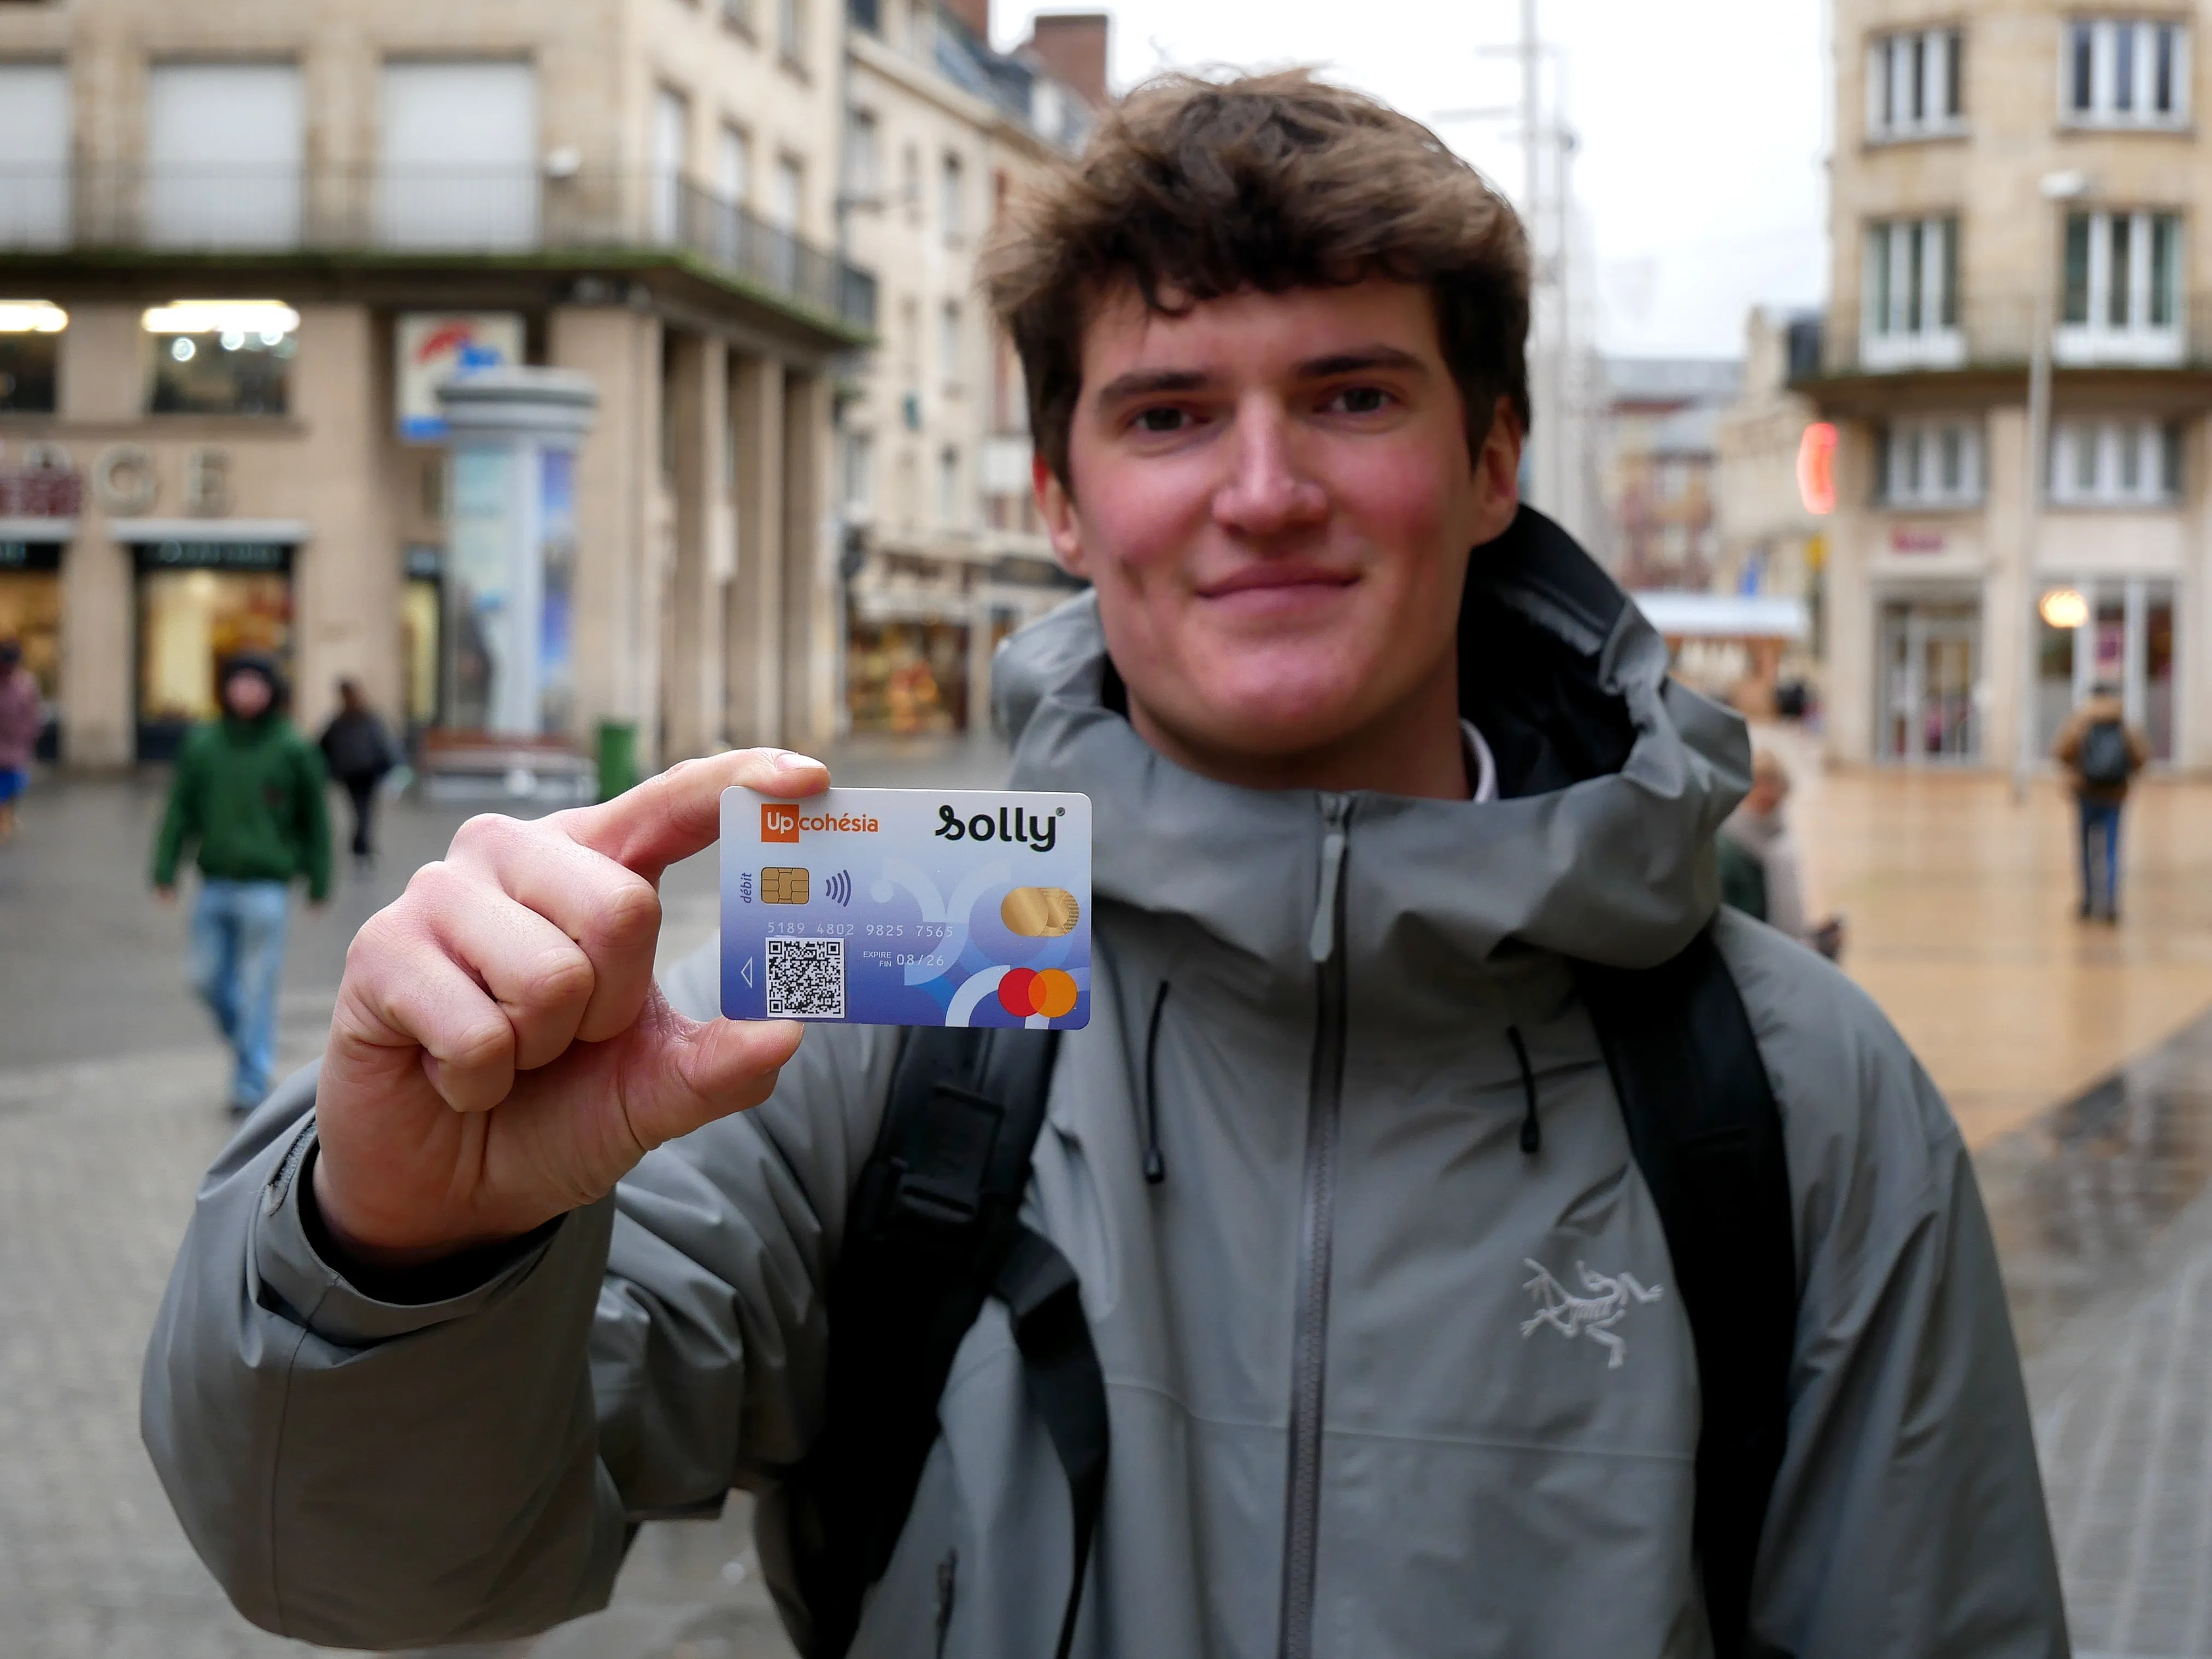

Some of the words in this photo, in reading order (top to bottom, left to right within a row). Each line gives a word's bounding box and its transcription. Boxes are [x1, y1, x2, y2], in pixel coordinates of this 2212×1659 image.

[767, 811, 794, 834] Up
[799, 813, 879, 833] cohésia
[740, 872, 752, 904] débit
[767, 922, 805, 934] 5189
[817, 923, 854, 935] 4802
[866, 924, 903, 936] 9825
[916, 925, 953, 937] 7565
[863, 951, 892, 959] EXPIRE
[896, 954, 944, 966] 08/26
